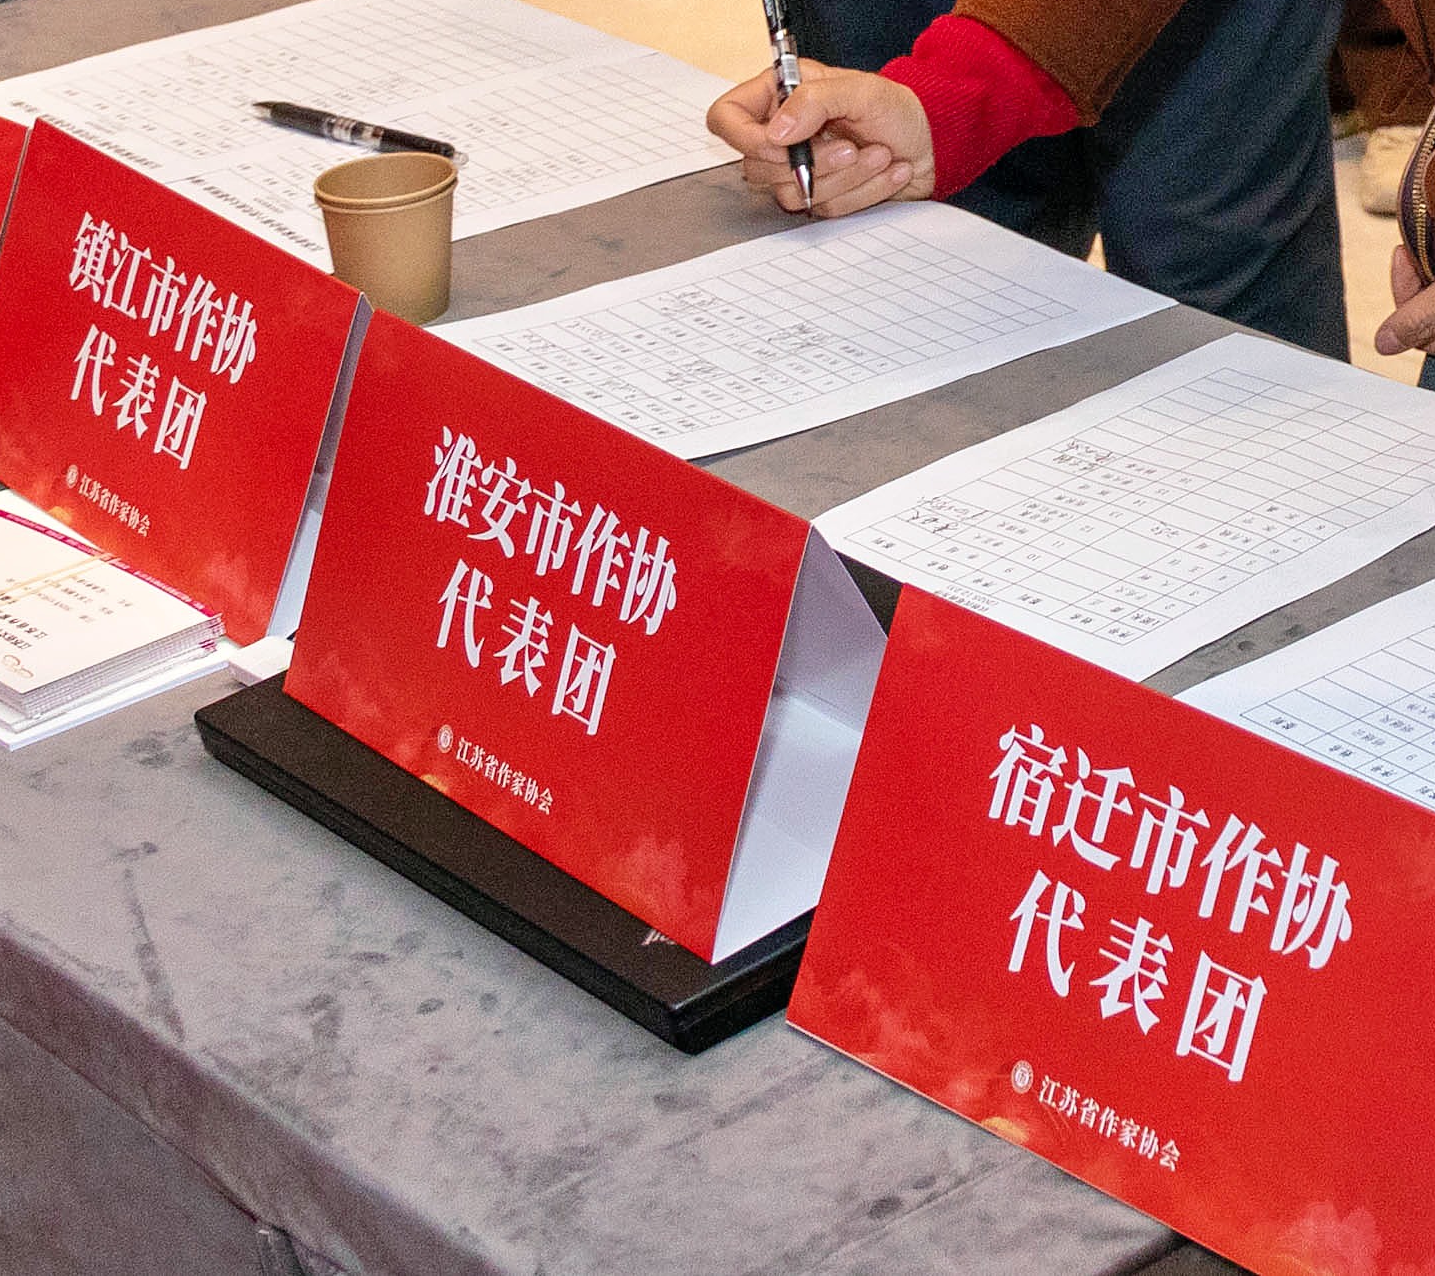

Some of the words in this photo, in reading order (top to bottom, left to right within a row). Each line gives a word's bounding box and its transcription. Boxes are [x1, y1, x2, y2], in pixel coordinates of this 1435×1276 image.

[69, 212, 257, 384] 镇江市作协
[71, 326, 207, 470] 代表团
[79, 474, 150, 537] 江苏省作家协会
[424, 426, 676, 635] 淮安市作协
[437, 559, 616, 735] 代表团
[456, 737, 553, 814] 江苏省作家协会
[989, 724, 1351, 969] 宿迁市作协
[1008, 870, 1267, 1082] 代表团
[1039, 1075, 1180, 1172] 江苏省作家协会
